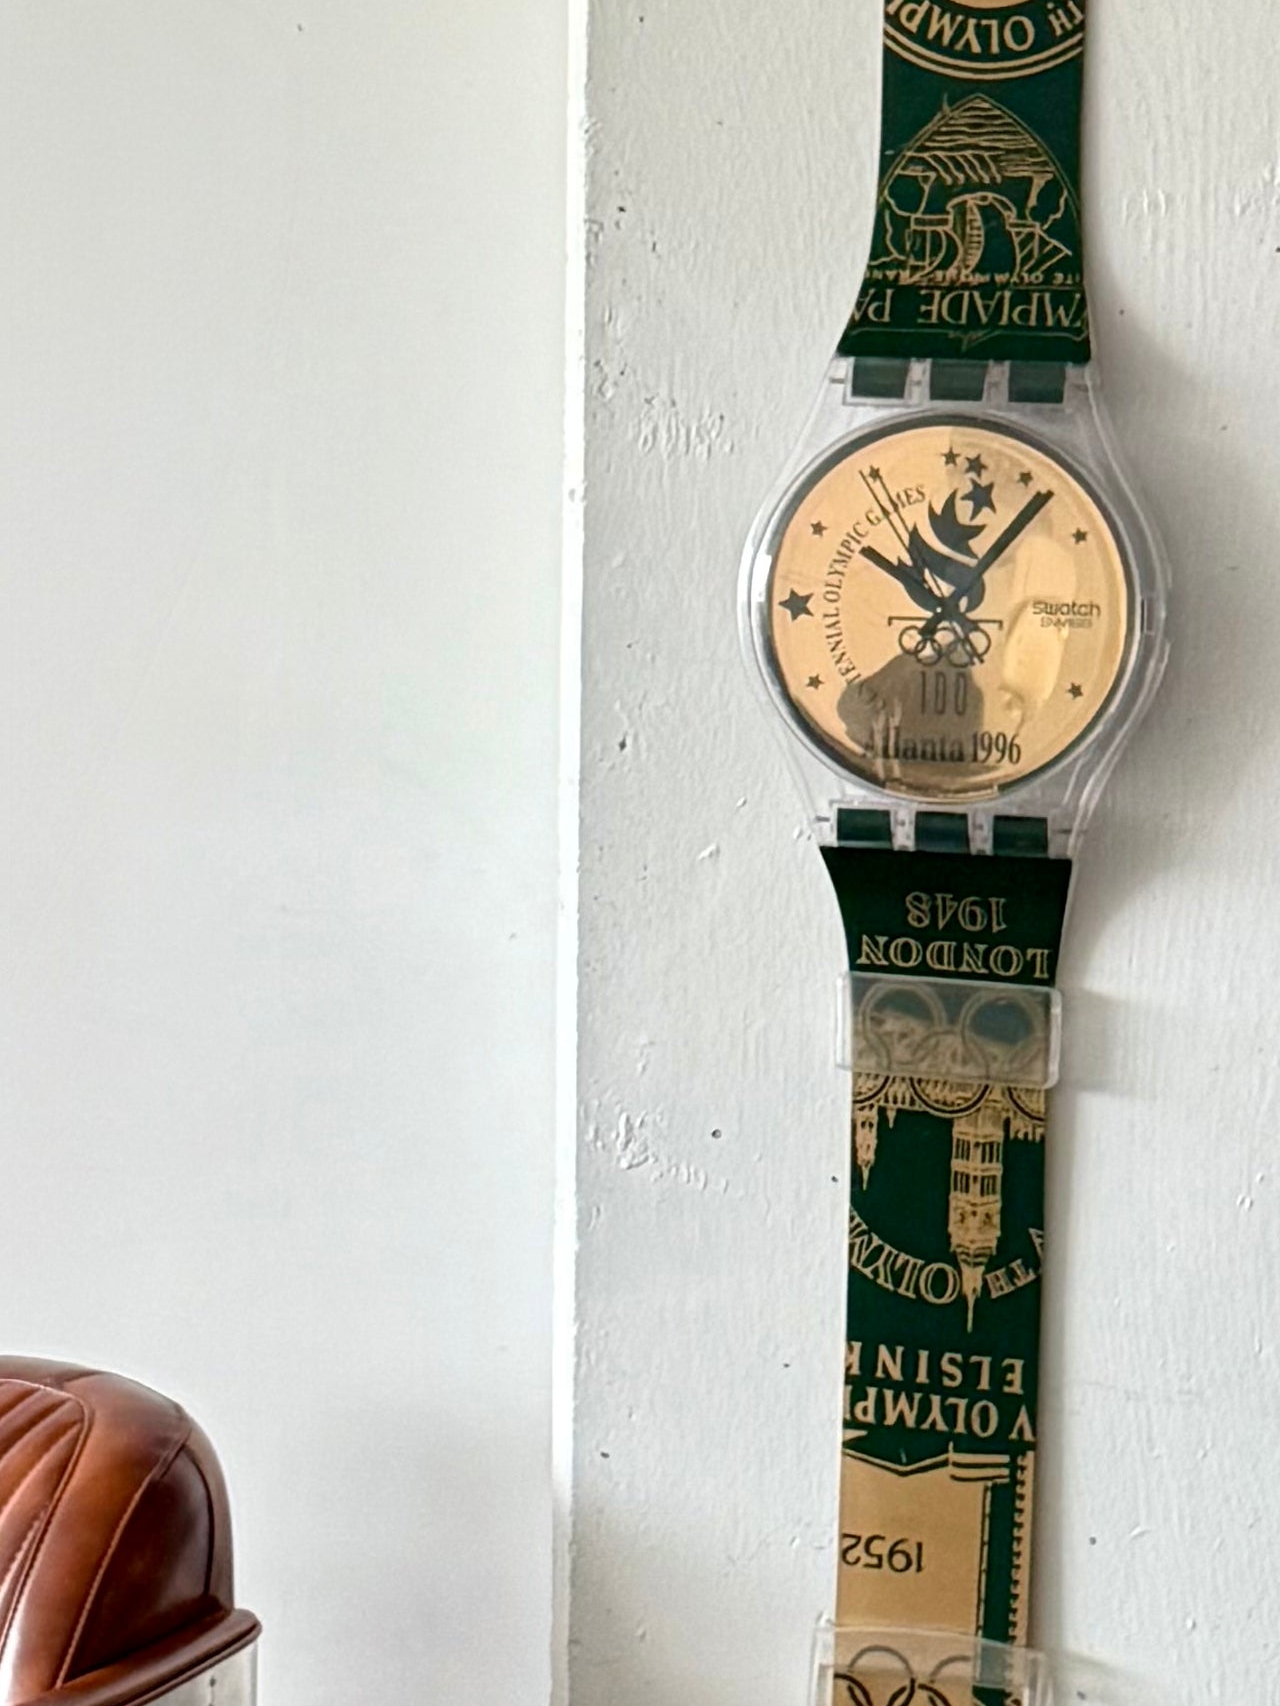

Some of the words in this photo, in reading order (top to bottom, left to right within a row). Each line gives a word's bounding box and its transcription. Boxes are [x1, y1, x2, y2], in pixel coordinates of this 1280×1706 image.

[823, 521, 870, 605] OLYMPIC
[920, 670, 968, 716] 100
[970, 731, 1022, 764] 1996
[905, 891, 1007, 934] 1948
[855, 934, 1051, 980] LONDON
[840, 1533, 925, 1575] 1952
